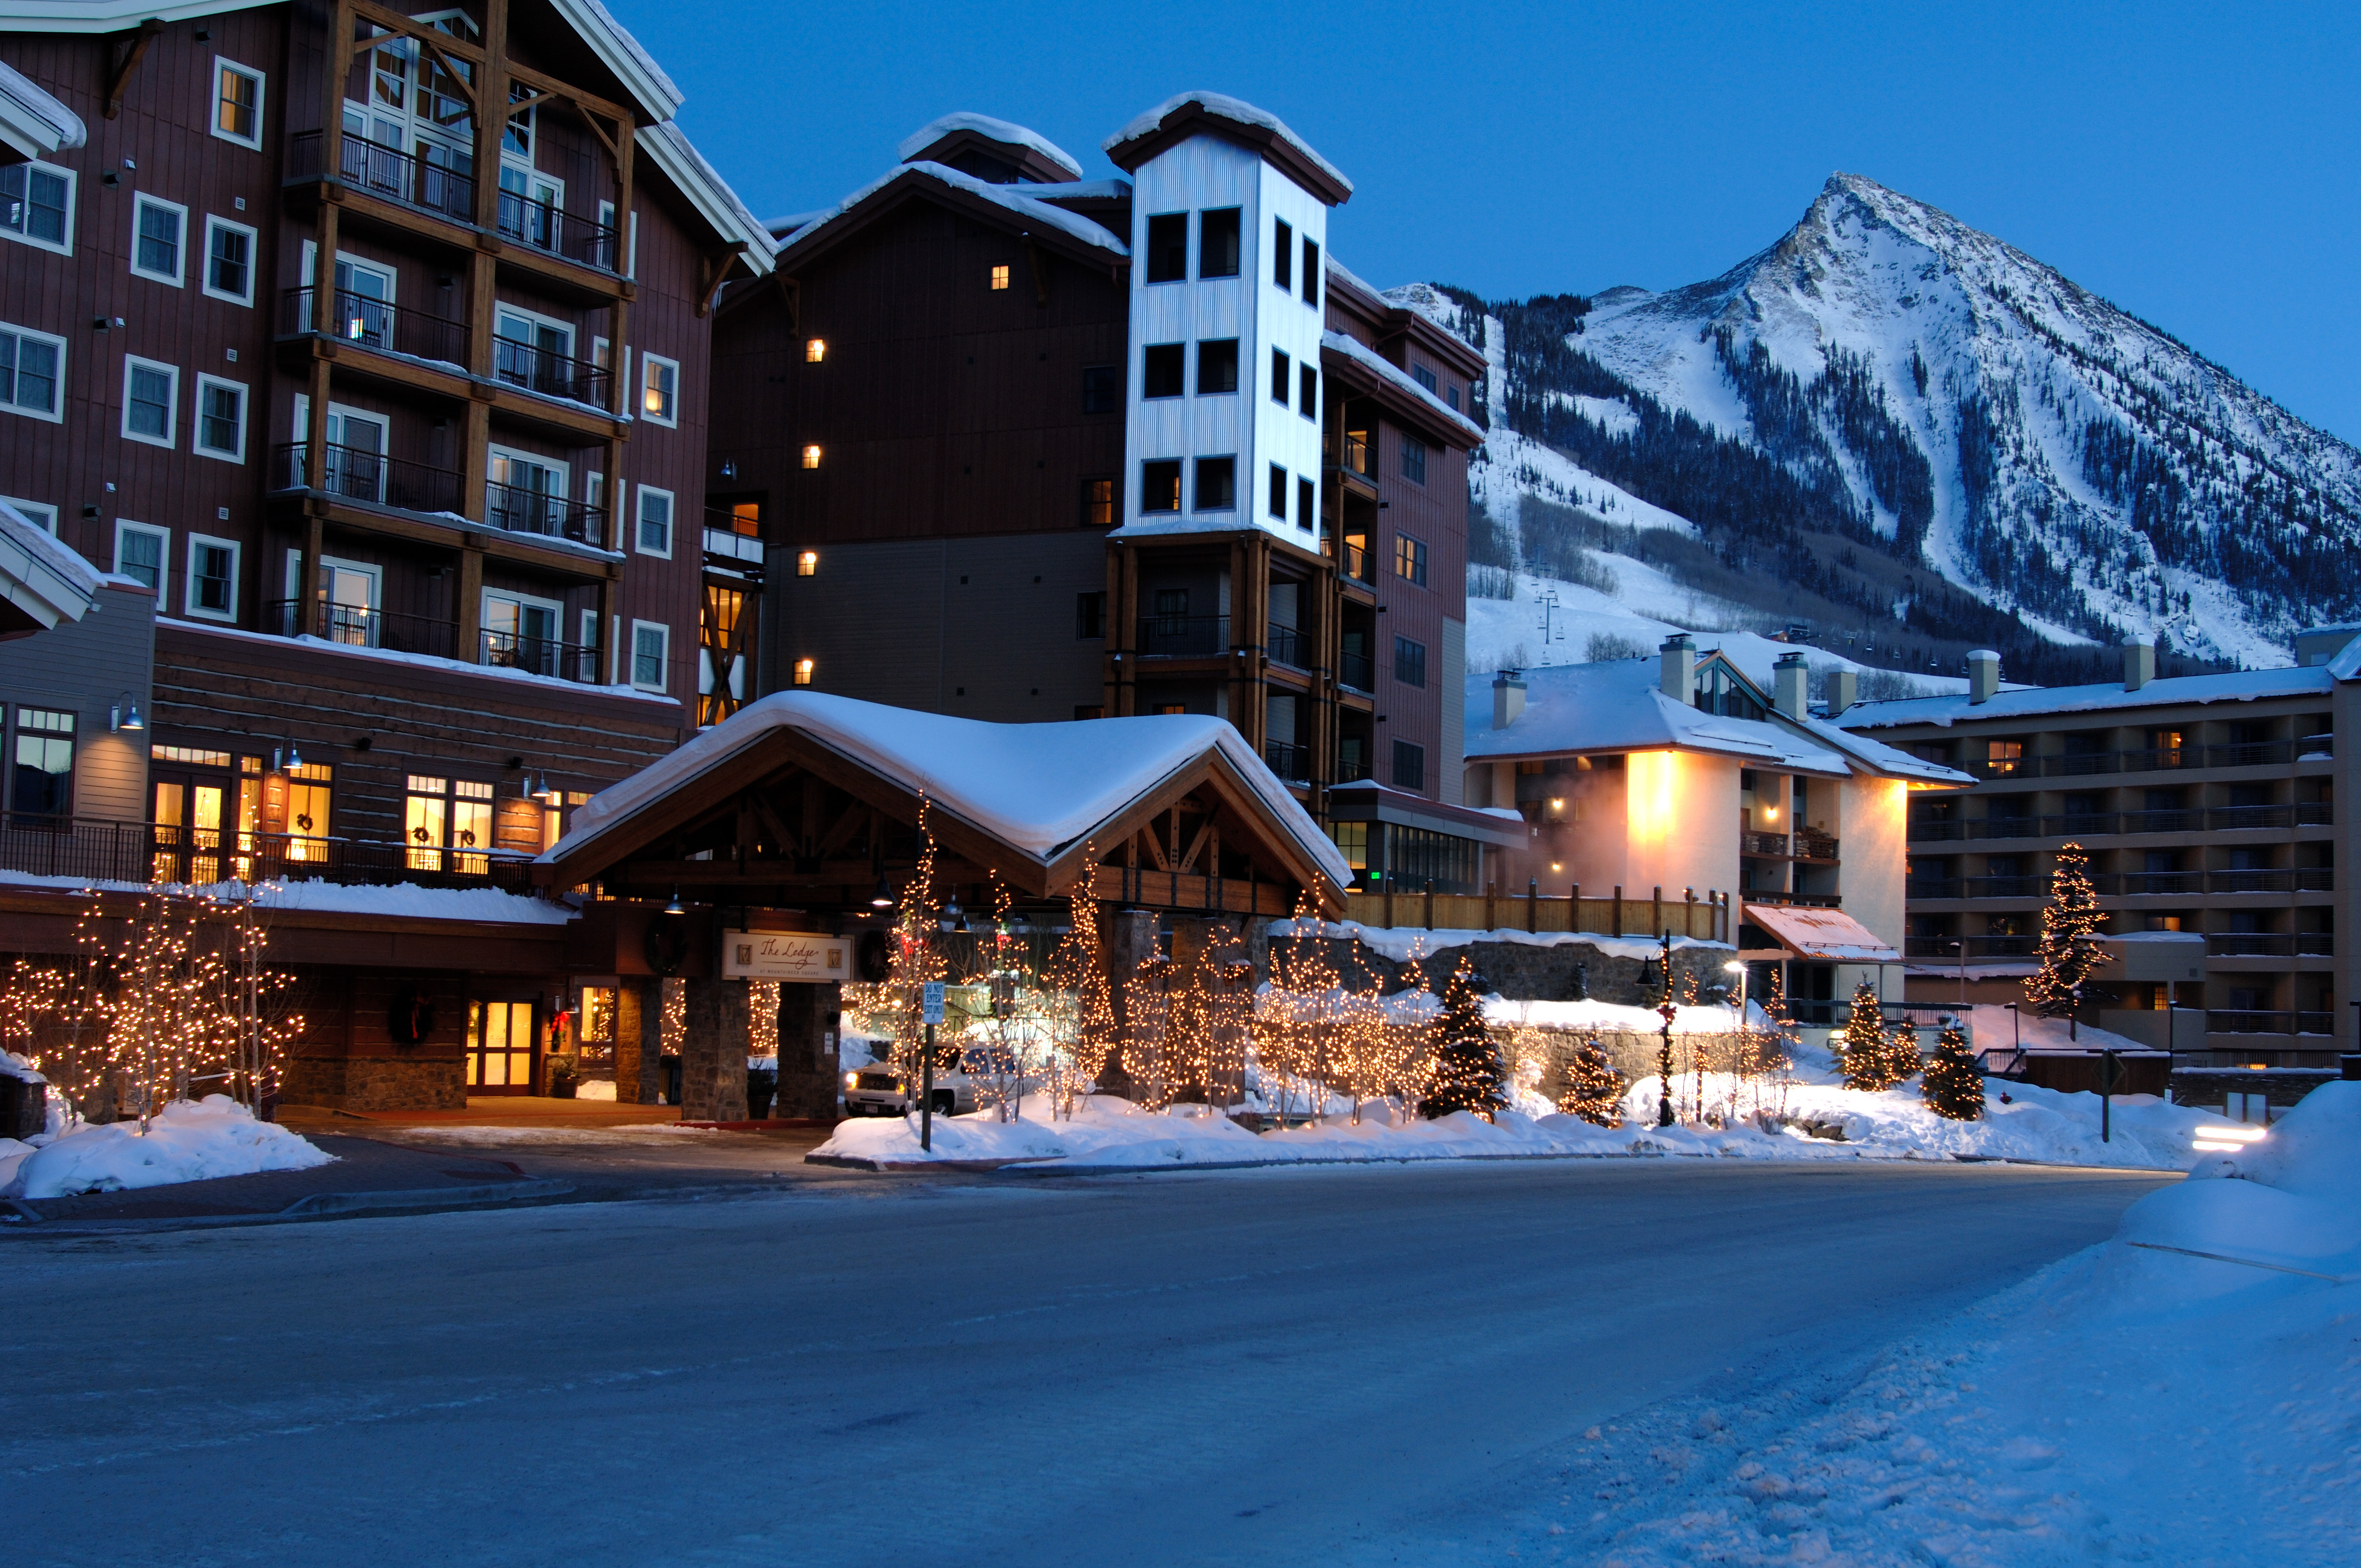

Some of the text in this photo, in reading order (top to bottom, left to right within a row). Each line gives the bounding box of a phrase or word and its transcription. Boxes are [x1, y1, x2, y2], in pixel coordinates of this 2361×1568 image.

[760, 939, 819, 970] The Lodge
[926, 984, 943, 993] DO NOT
[927, 994, 941, 1003] ENTER
[933, 1005, 942, 1013] ONLY
